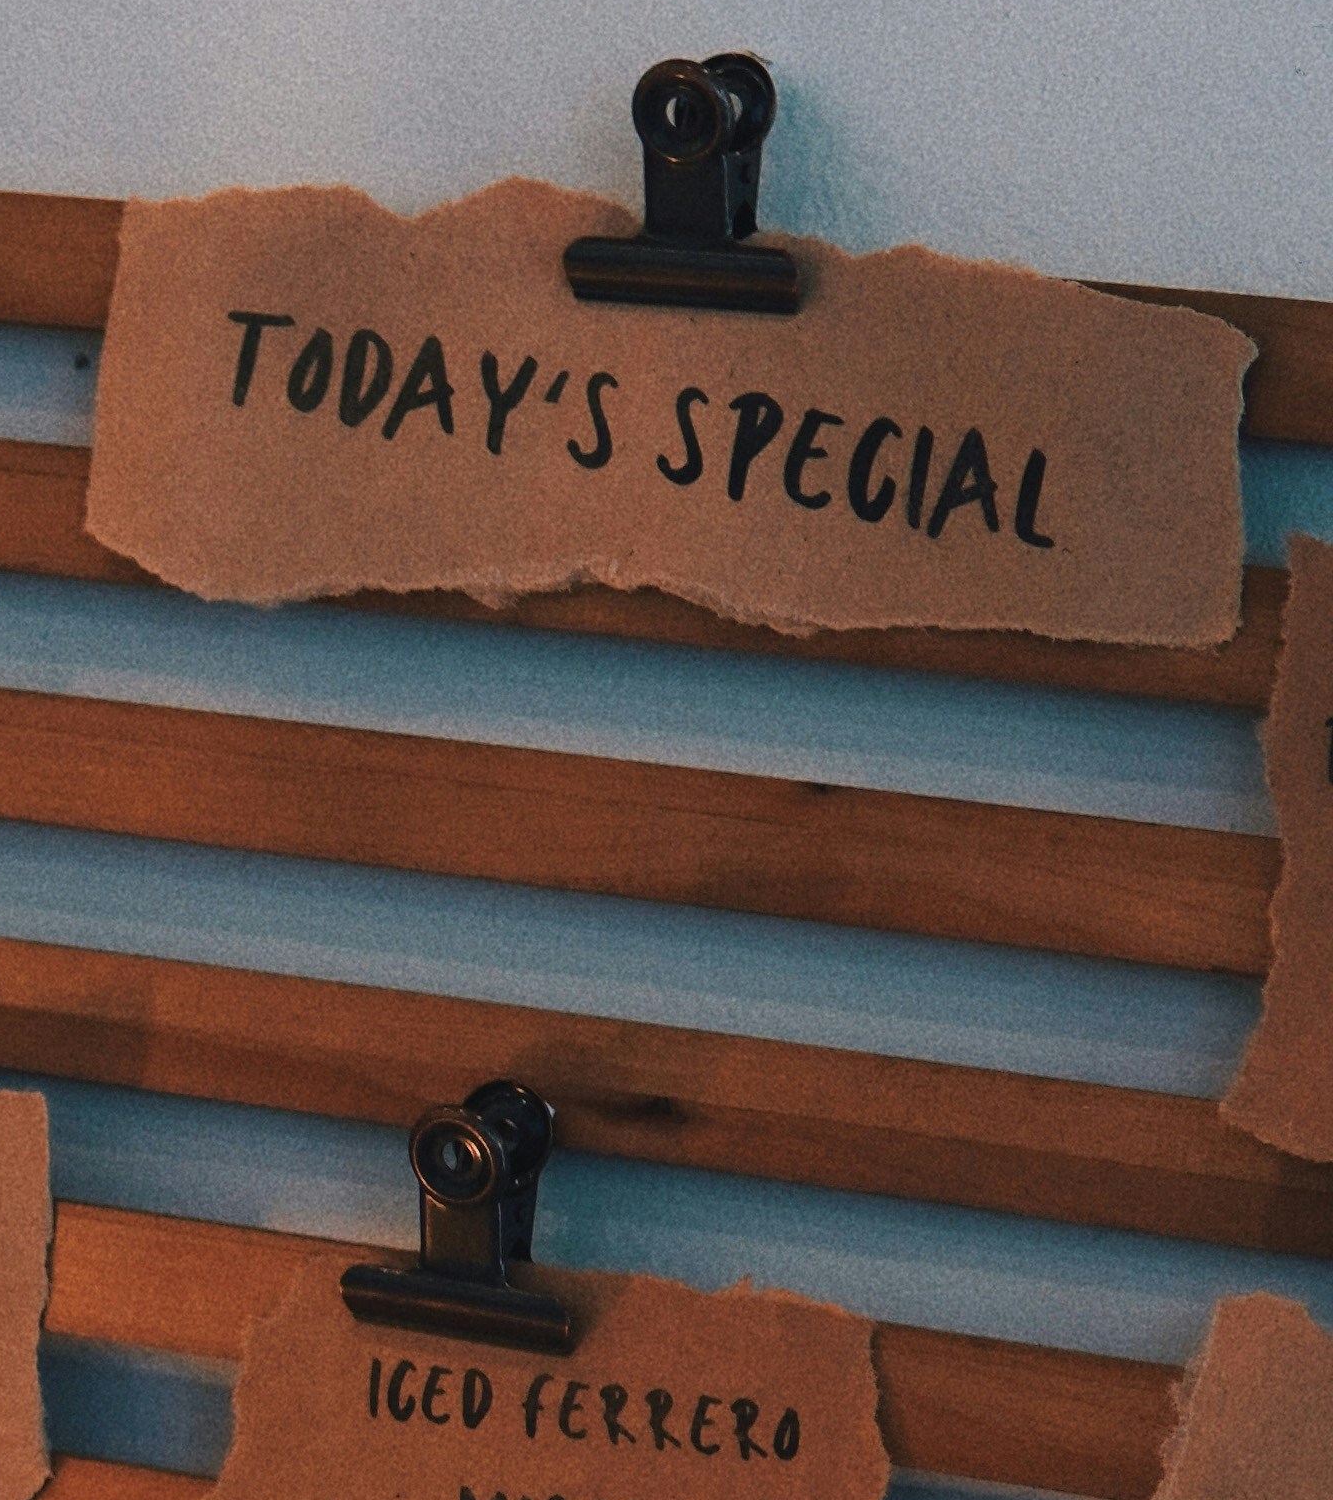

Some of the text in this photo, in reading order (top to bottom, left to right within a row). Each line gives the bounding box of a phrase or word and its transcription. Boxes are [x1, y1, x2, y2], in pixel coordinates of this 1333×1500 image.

[228, 310, 1055, 549] TODAY'S SPECIAL
[368, 1359, 801, 1461] ICED FERRERO
